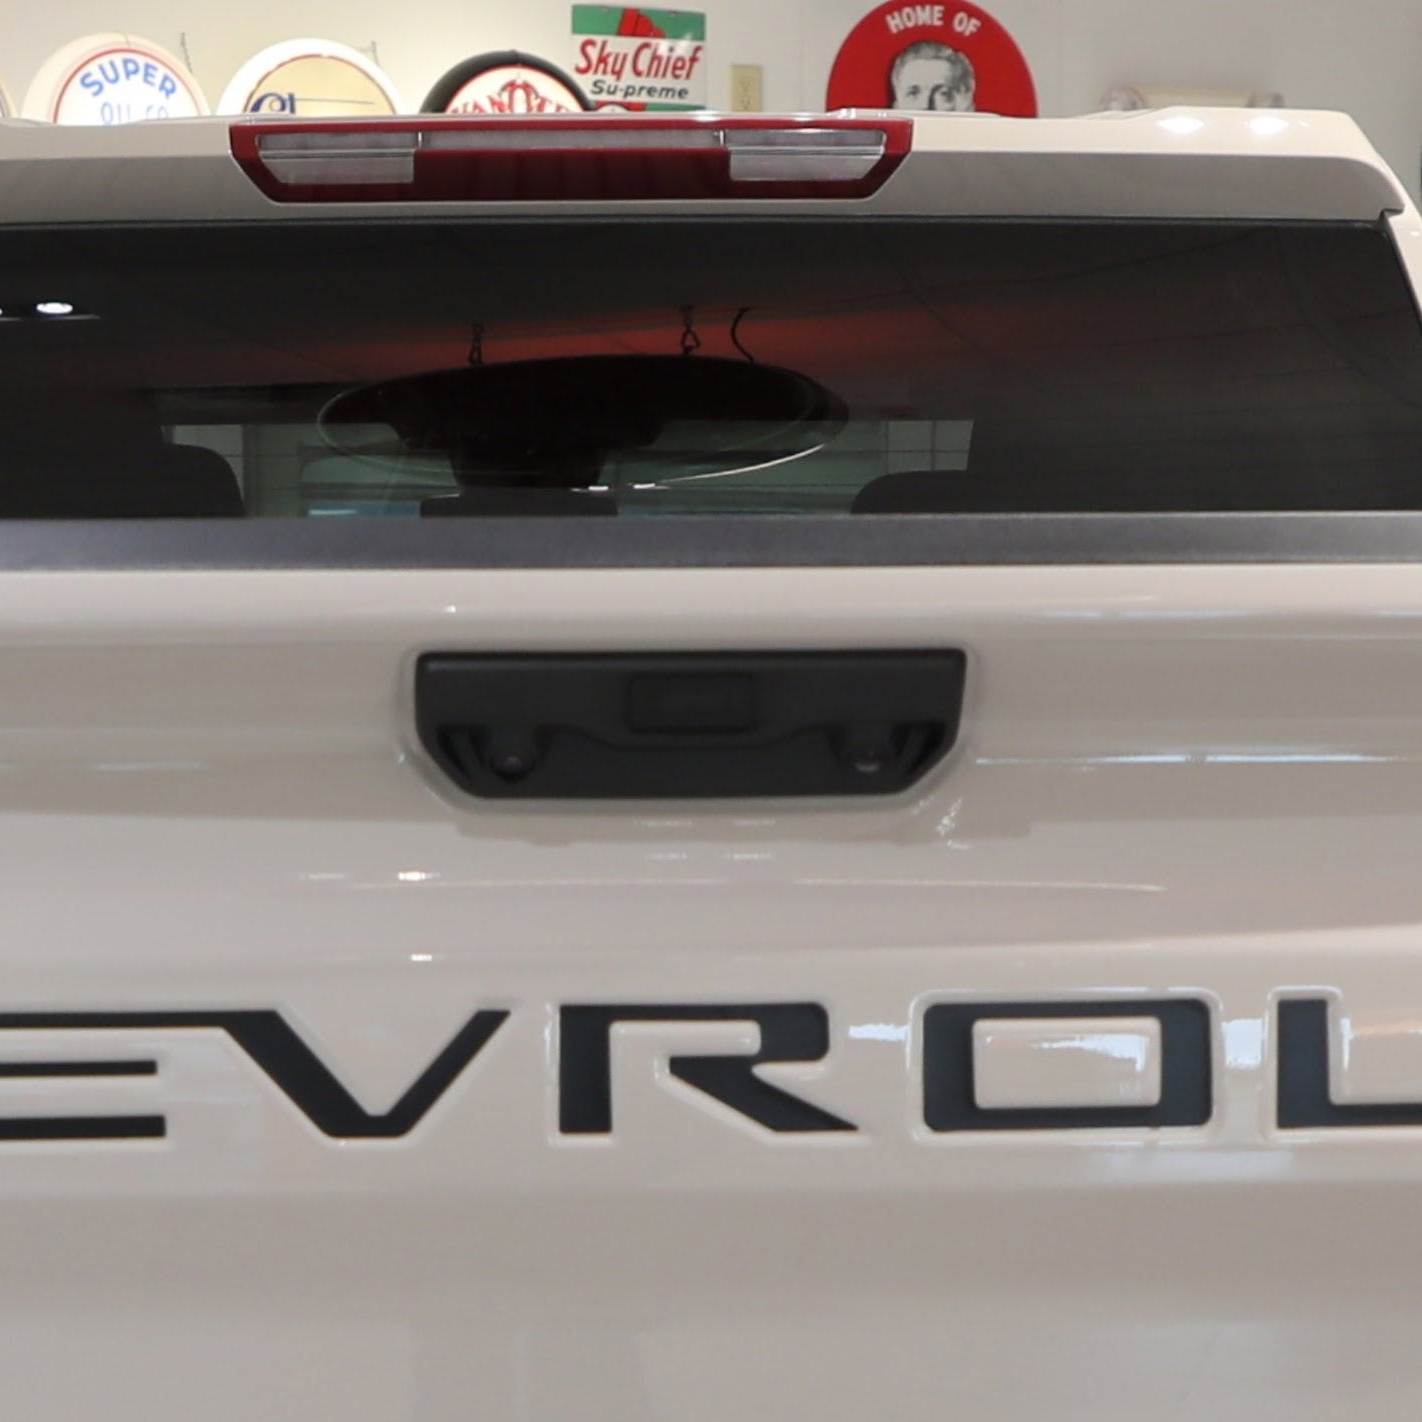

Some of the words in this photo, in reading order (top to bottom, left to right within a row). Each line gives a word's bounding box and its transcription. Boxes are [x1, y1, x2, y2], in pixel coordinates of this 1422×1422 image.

[886, 6, 944, 34] HOME
[953, 12, 981, 36] OF
[80, 58, 176, 99] SUPER
[575, 39, 628, 81] Sky
[633, 42, 705, 80] Chief
